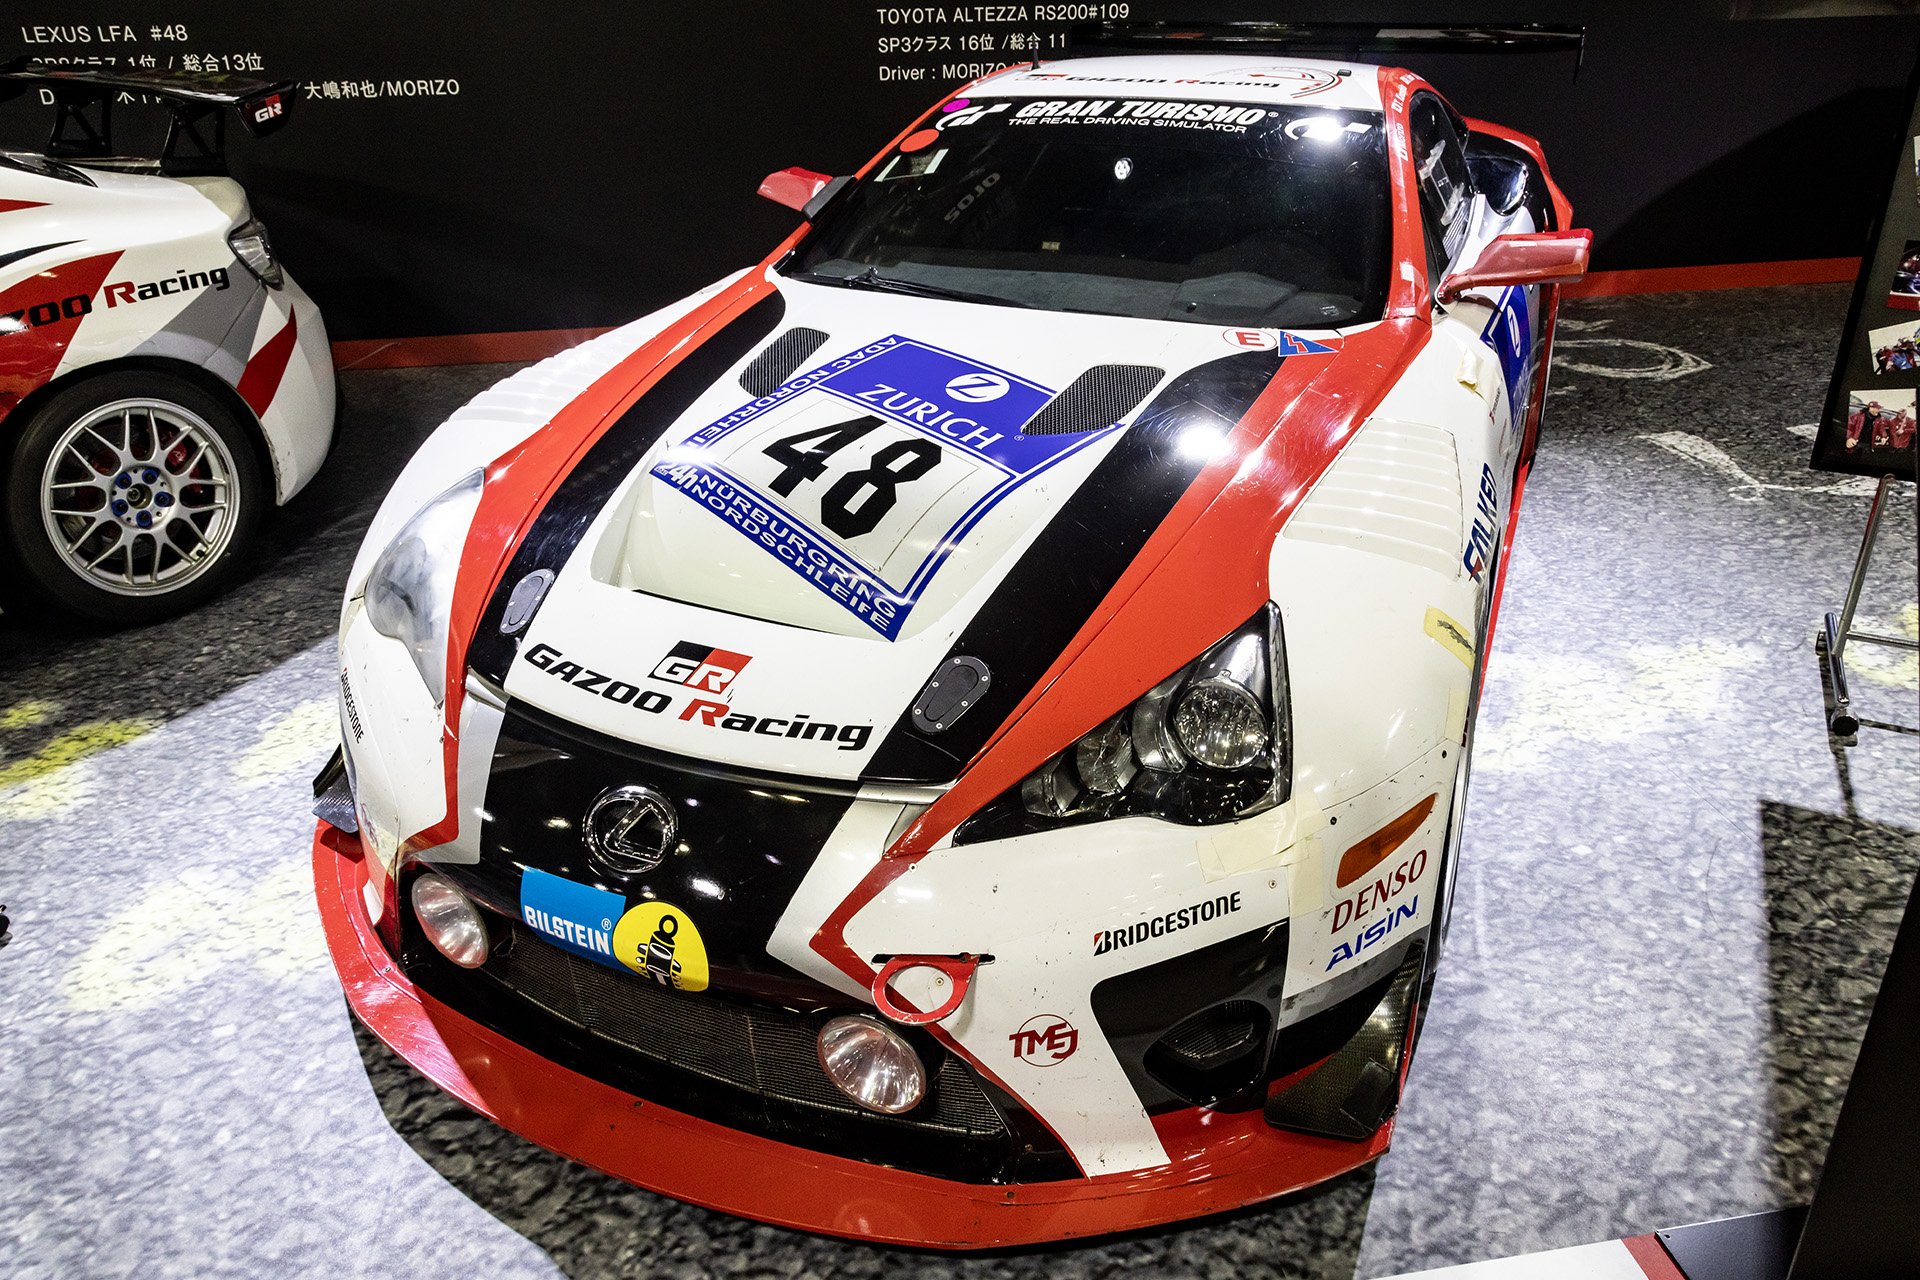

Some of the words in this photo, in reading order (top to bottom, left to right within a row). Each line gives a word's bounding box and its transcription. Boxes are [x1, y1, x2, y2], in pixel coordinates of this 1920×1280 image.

[21, 26, 92, 43] LEXUS
[97, 25, 137, 42] LFA
[150, 24, 189, 42] #48
[877, 8, 947, 25] TOYOTA
[953, 6, 1029, 23] ALTEZZA
[1034, 3, 1130, 21] RS200#109
[182, 52, 265, 73] 総合13位
[878, 35, 951, 53] SP3クラス
[959, 33, 995, 51] 16位
[879, 65, 926, 82] Driver
[254, 102, 283, 123] GR
[1008, 117, 1039, 126] THE
[1039, 116, 1081, 125] REAL
[1083, 117, 1150, 126] DRIVING
[1152, 118, 1248, 133] SIMULATOR
[1015, 100, 1116, 118] GRAN
[103, 266, 231, 309] Racing
[831, 336, 898, 369] ADAC
[686, 369, 831, 449] NORDRHEI
[855, 383, 1005, 450] ZURICH
[761, 414, 943, 541] 48
[691, 484, 891, 631] NORDSCHLEIFE
[699, 473, 897, 619] NÜRBURGRING
[524, 643, 673, 715] GAZOO
[678, 698, 875, 751] Racing
[654, 655, 738, 693] GR
[340, 668, 365, 744] BRIDGESTONE
[1330, 848, 1428, 935] DENSO
[523, 903, 612, 956] BILSTEIN
[1093, 890, 1242, 957] BRIDGESTONE
[1324, 894, 1419, 972] AISIN
